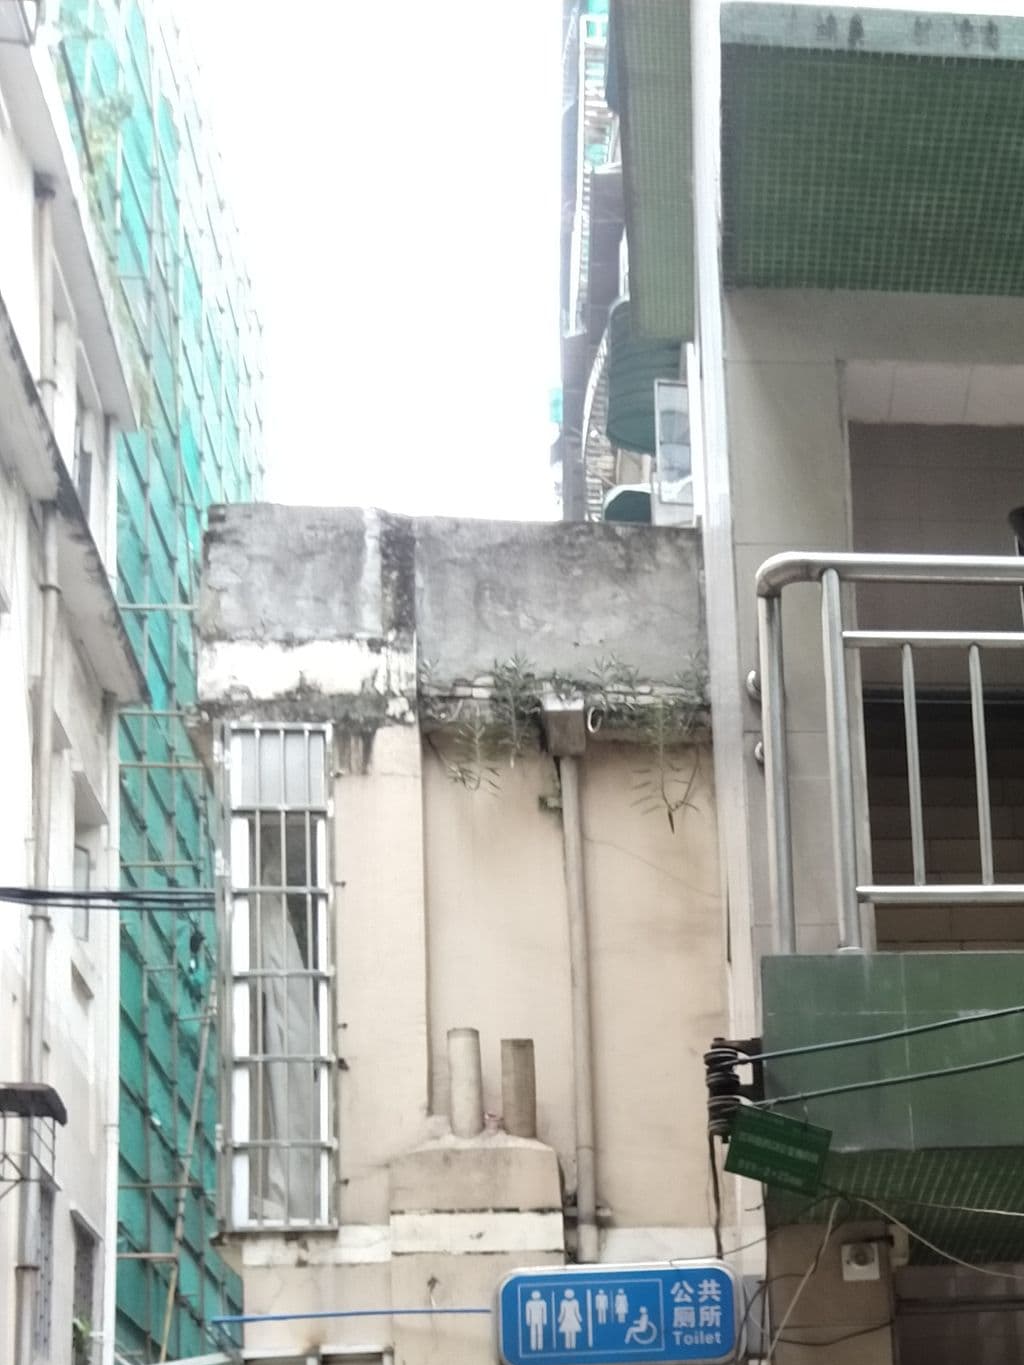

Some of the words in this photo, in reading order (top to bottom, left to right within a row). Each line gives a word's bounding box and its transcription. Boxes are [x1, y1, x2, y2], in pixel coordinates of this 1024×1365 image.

[670, 1279, 722, 1304] 公共
[672, 1305, 722, 1329] 厕所
[672, 1330, 722, 1346] Toilet
